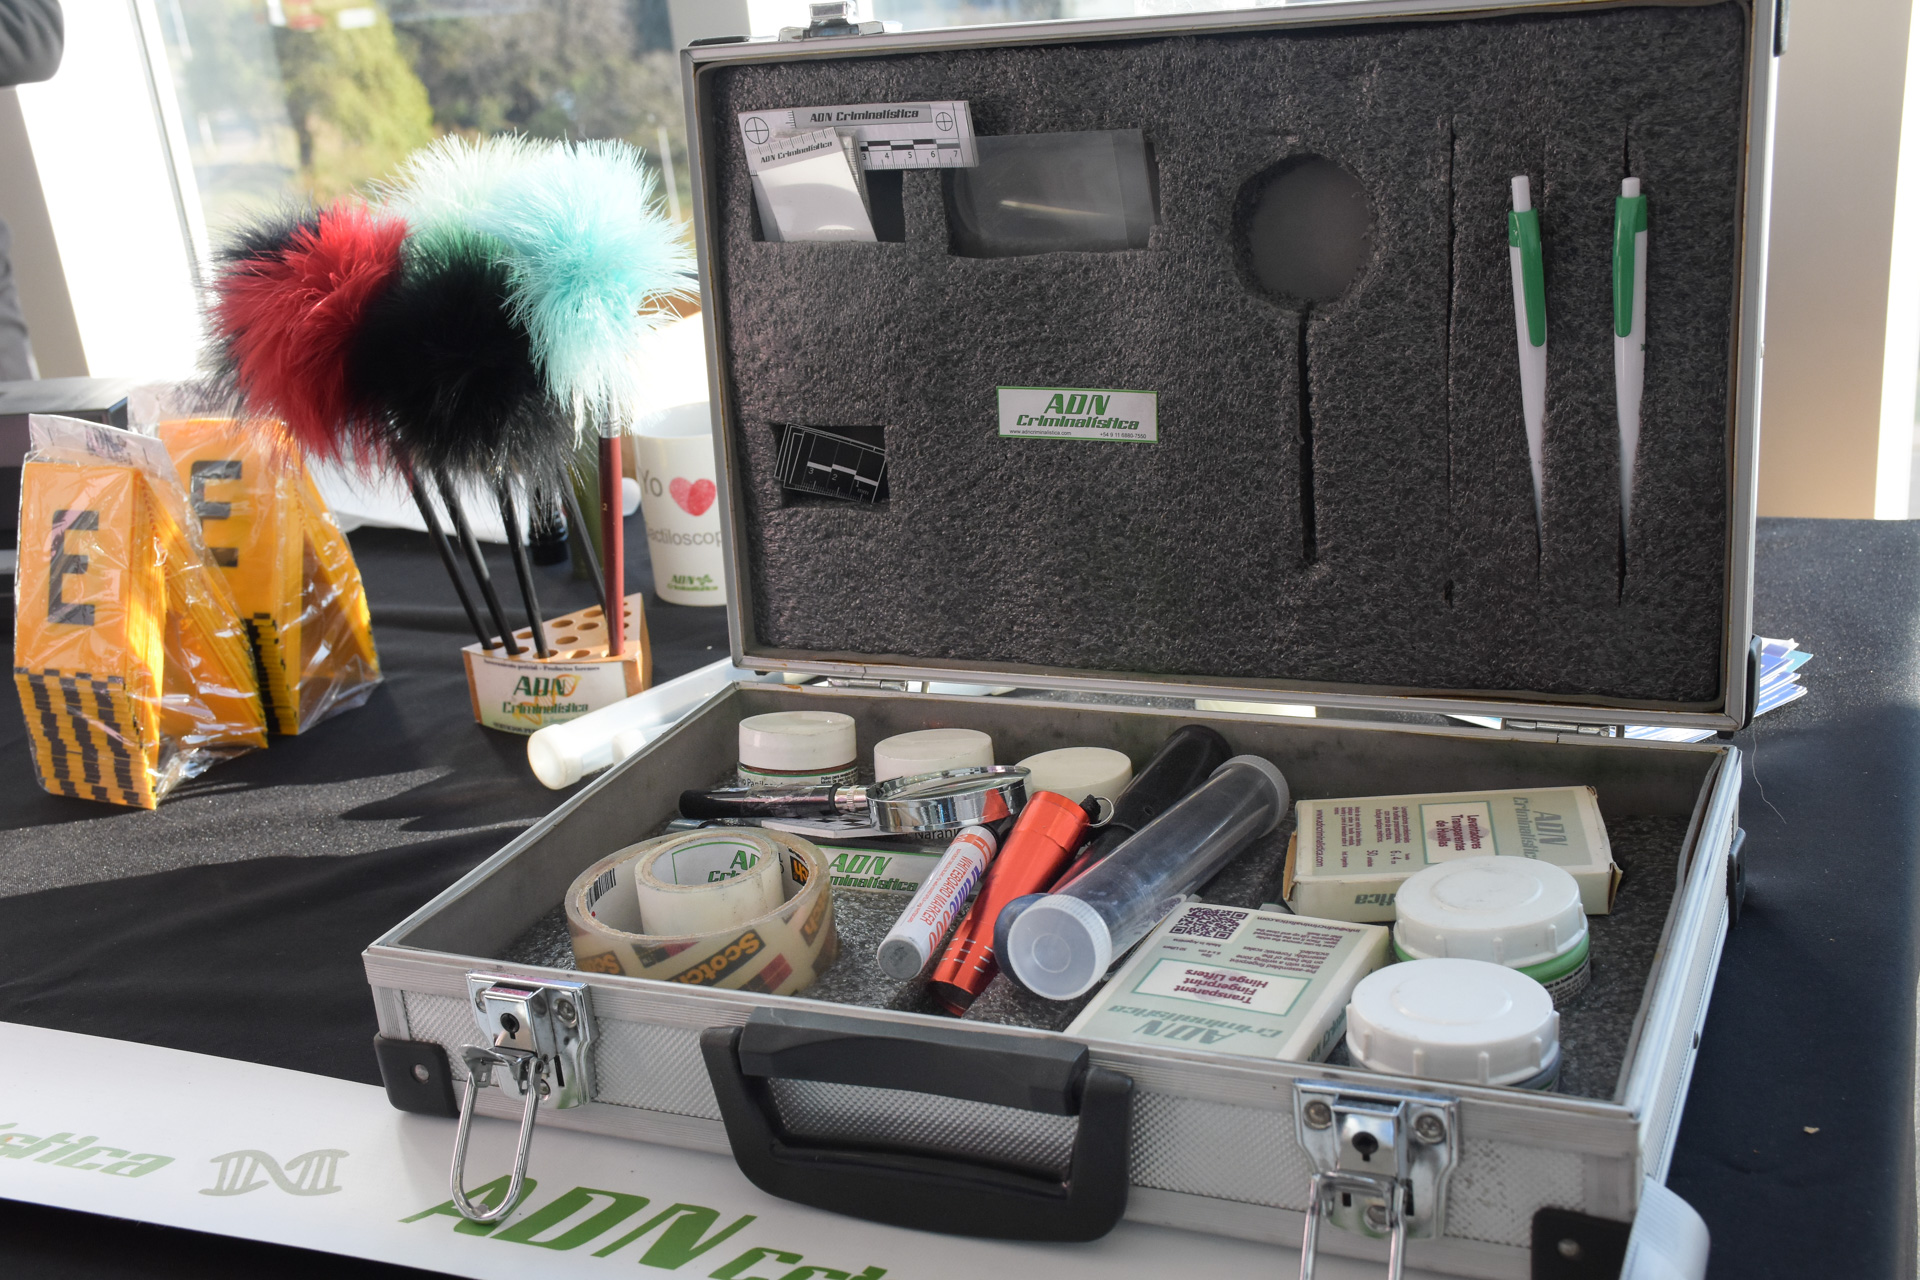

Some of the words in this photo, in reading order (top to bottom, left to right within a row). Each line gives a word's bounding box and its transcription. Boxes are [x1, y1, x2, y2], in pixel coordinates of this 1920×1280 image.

[810, 112, 832, 123] ADN
[760, 154, 775, 164] ADN
[884, 151, 890, 159] 4
[908, 151, 913, 159] 5
[1044, 393, 1111, 415] ADN
[1016, 415, 1139, 430] Criminalística
[808, 467, 814, 475] 3
[191, 460, 242, 567] E
[648, 528, 722, 547] actiloscop
[47, 510, 99, 625] E
[513, 675, 566, 697] ADN
[1437, 827, 1451, 847] Huellas
[1450, 814, 1465, 851] Transparentes
[1467, 814, 1482, 849] Levantadores
[1513, 797, 1539, 859] Criminalístic
[1533, 810, 1568, 846] ADN
[829, 853, 893, 875] ADN
[938, 855, 974, 898] WHITEBOARD
[920, 896, 948, 926] MARKER
[1183, 977, 1258, 995] Fingerprint
[1185, 969, 1227, 982] Lifters
[1228, 975, 1269, 988] Hinge
[1173, 985, 1252, 1004] Transparent
[1133, 1019, 1236, 1044] ADN
[398, 1175, 758, 1271] ADN
